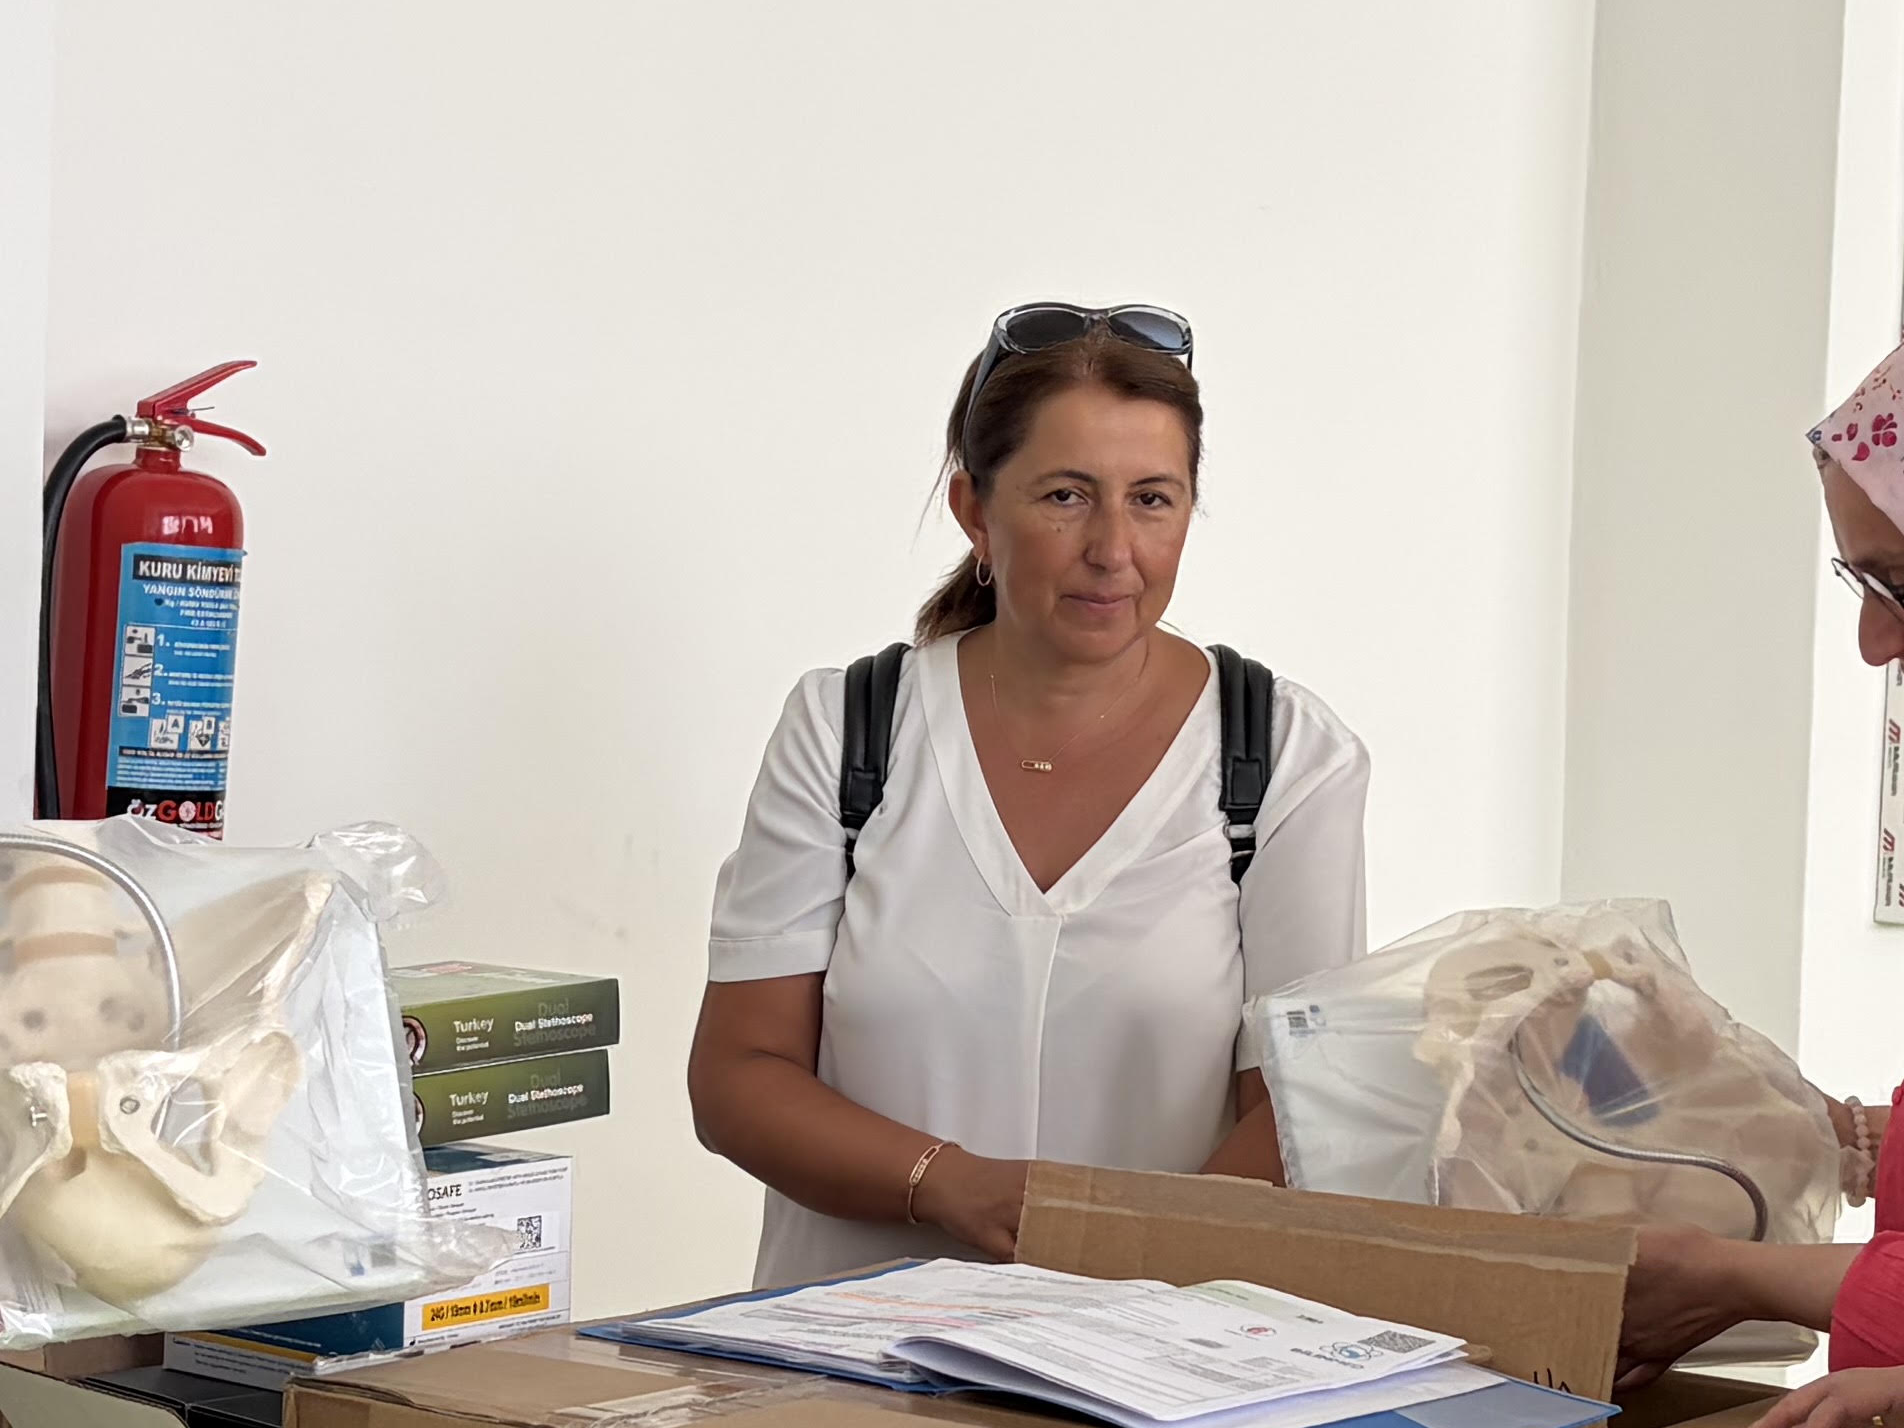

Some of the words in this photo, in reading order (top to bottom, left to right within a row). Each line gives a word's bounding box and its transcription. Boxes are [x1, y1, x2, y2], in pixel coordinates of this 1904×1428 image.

[139, 560, 183, 580] KURU
[143, 583, 187, 598] YANGIN
[453, 1017, 494, 1034] Turkey
[514, 1020, 536, 1033] Dual
[538, 1013, 593, 1029] Stethoscope
[449, 1090, 489, 1107] Turkey
[508, 1092, 529, 1104] Dual
[531, 1084, 584, 1101] Stethoscope
[427, 1183, 463, 1201] OSAFE
